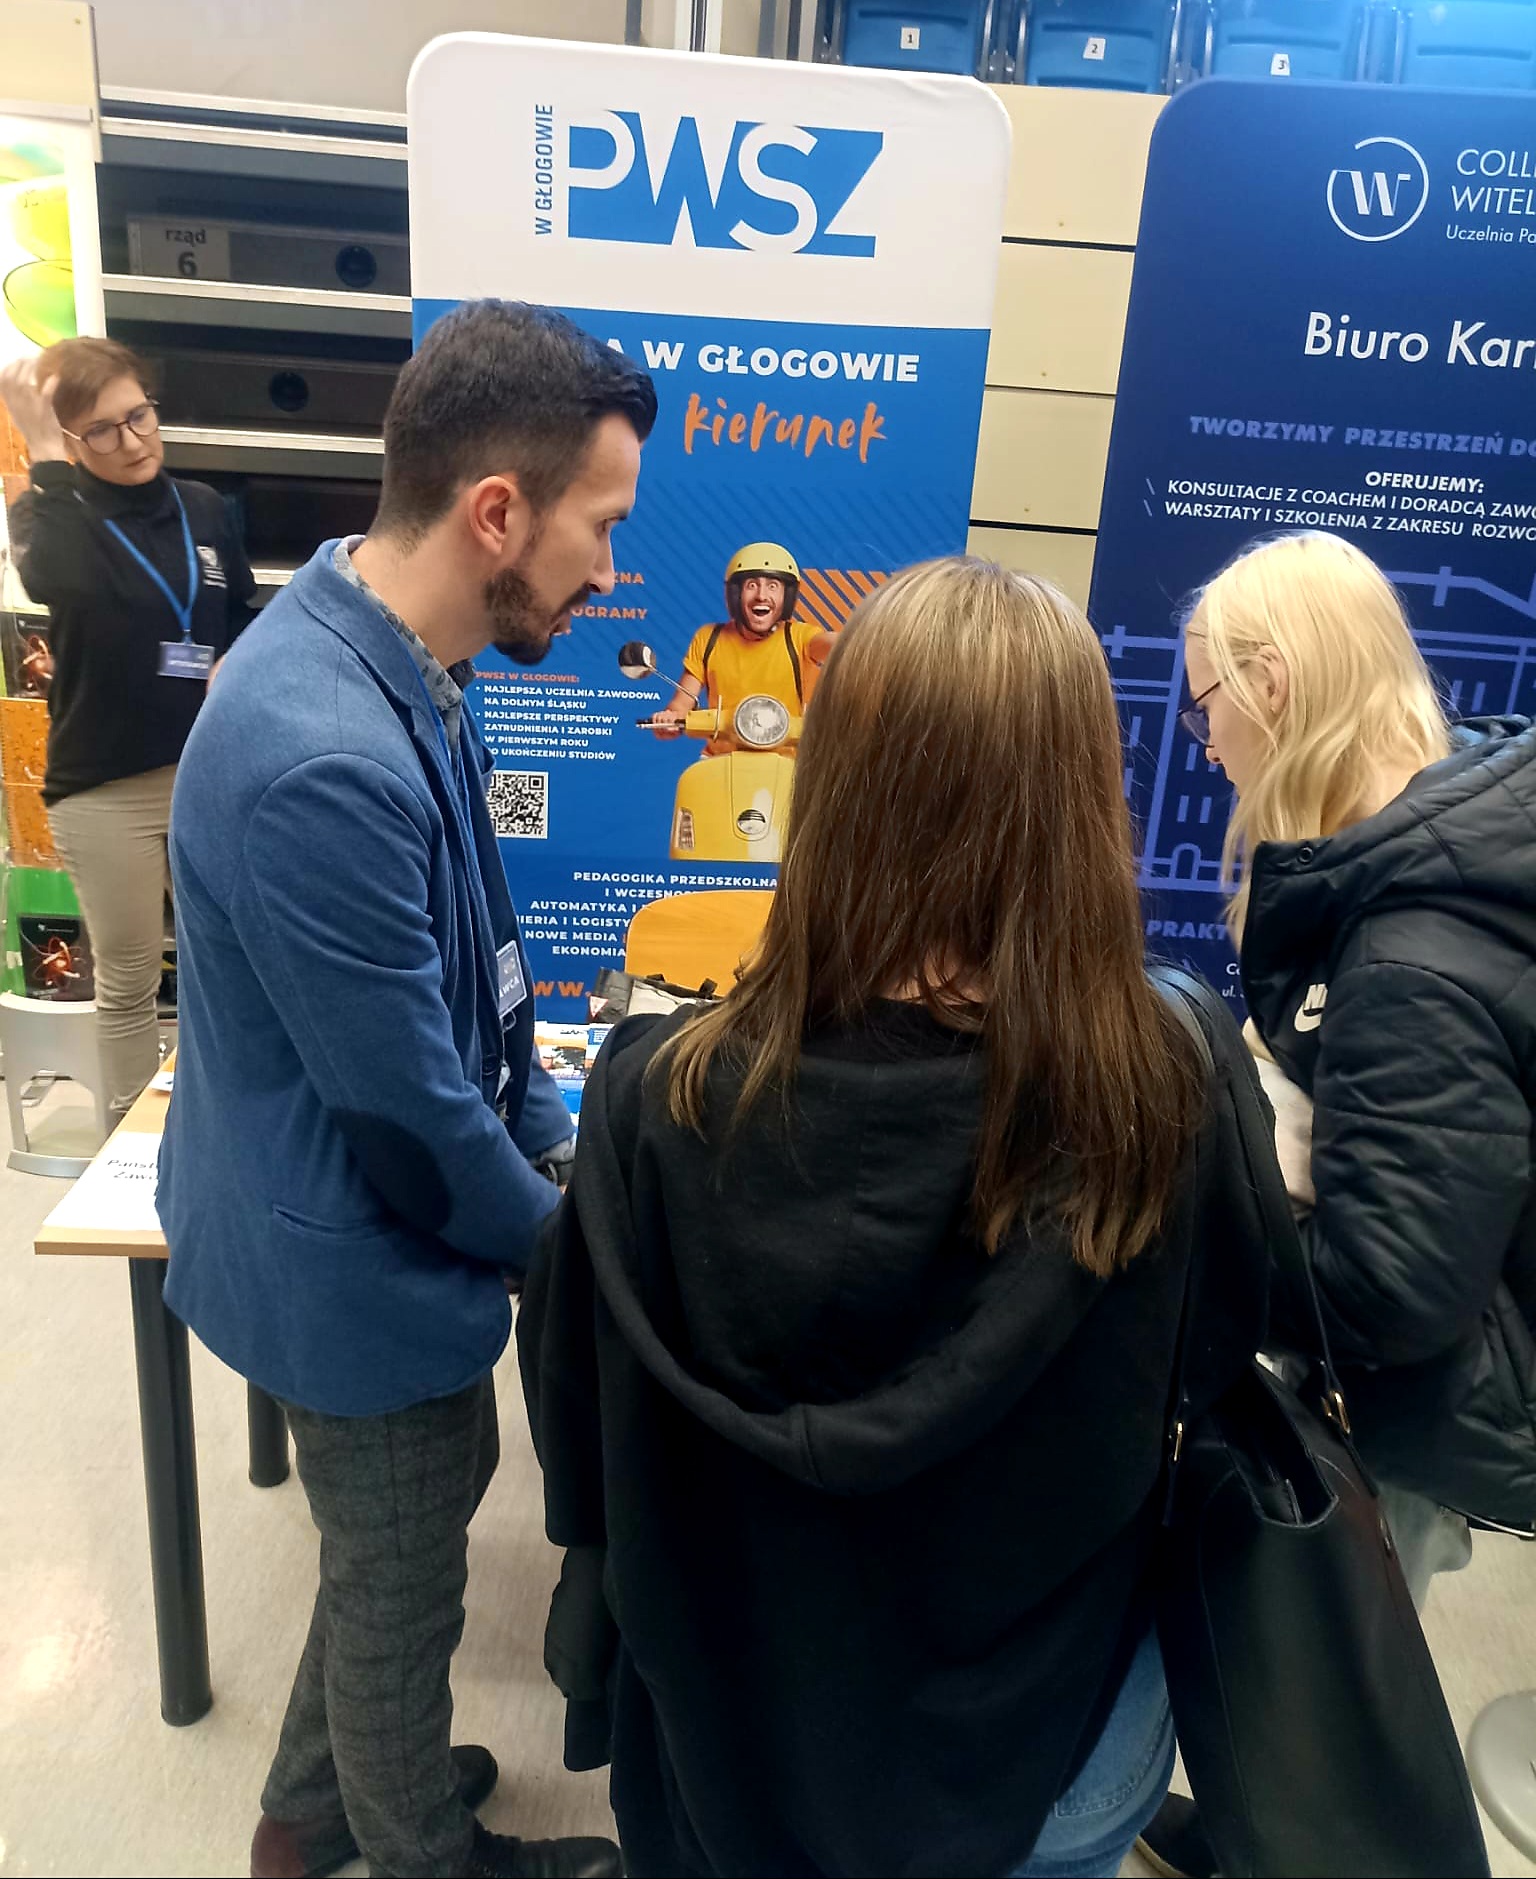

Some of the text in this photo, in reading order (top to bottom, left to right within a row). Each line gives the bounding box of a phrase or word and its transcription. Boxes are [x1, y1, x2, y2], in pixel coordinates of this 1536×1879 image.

[1091, 43, 1098, 54] 2
[1278, 59, 1286, 70] 3
[534, 103, 553, 236] W GŁOGOWIE
[1456, 149, 1536, 178] COLL
[568, 108, 884, 259] PWSZ
[1451, 185, 1536, 215] WITEL
[165, 229, 206, 247] rząd
[1446, 224, 1513, 243] Uczelnia
[178, 251, 197, 277] 6
[1304, 311, 1536, 369] Biuro Kar
[642, 340, 685, 371] W
[698, 344, 920, 383] GŁOGOWIE
[684, 392, 887, 464] kierunek
[1189, 416, 1334, 444] TWORZYMY
[1344, 427, 1504, 456] PRZESTRZEŃ
[1365, 470, 1485, 495] OFERUJEMY:
[1167, 479, 1284, 502] KONSULTACJE
[1287, 488, 1298, 502] Z
[1301, 489, 1387, 509] COACHEM
[1400, 496, 1486, 520] DORADCĄ
[1164, 501, 1262, 522] WARSZTATY
[1274, 508, 1368, 529] SZKOLENIA
[1371, 516, 1384, 530] Z
[1386, 516, 1464, 536] ZAKRESU
[484, 685, 661, 700] NAJLEPSZA UCZELNIA ZAWODOWA
[484, 697, 587, 710] NA DOLNYM ŚLĄSKU
[484, 711, 619, 724] NAJLEPSZE PERSPEKTYWY
[484, 723, 559, 734] ZATRUDNIENIA
[567, 727, 613, 736] ZAROBKI
[484, 735, 589, 747] W PIERWSZYM ROKU
[501, 747, 566, 758] UKOŃCZENIU
[568, 749, 616, 760] STUDIÓW
[573, 871, 778, 888] PEDAGOGIKA PRZEDSZKOLNA
[614, 888, 690, 899] WCZESN
[530, 901, 627, 912] AUTOMATYKA
[525, 930, 568, 940] NOWE
[572, 932, 618, 942] MEDIA
[1146, 919, 1227, 941] PRAKT
[552, 946, 626, 957] EKONOMIA
